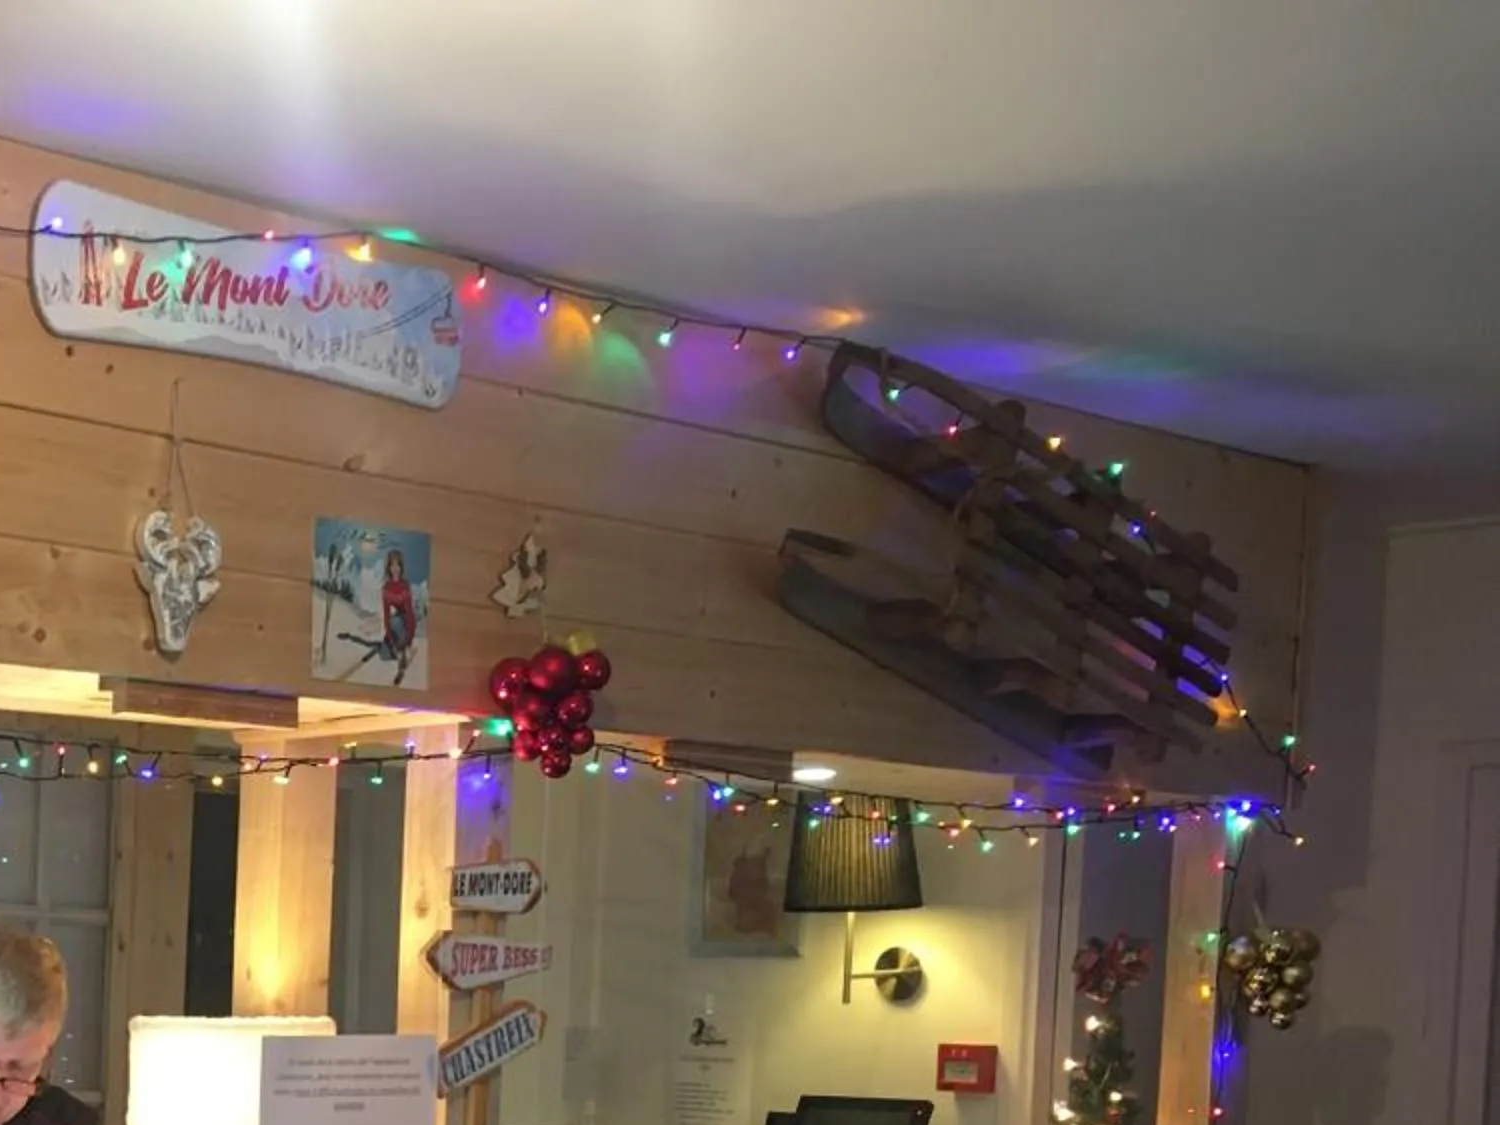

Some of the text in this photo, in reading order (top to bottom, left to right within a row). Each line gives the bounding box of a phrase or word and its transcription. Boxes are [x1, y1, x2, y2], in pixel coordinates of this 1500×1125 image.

[120, 252, 169, 312] Le
[181, 257, 291, 314] Mont
[453, 871, 464, 897] LE
[450, 941, 498, 977] SUPER
